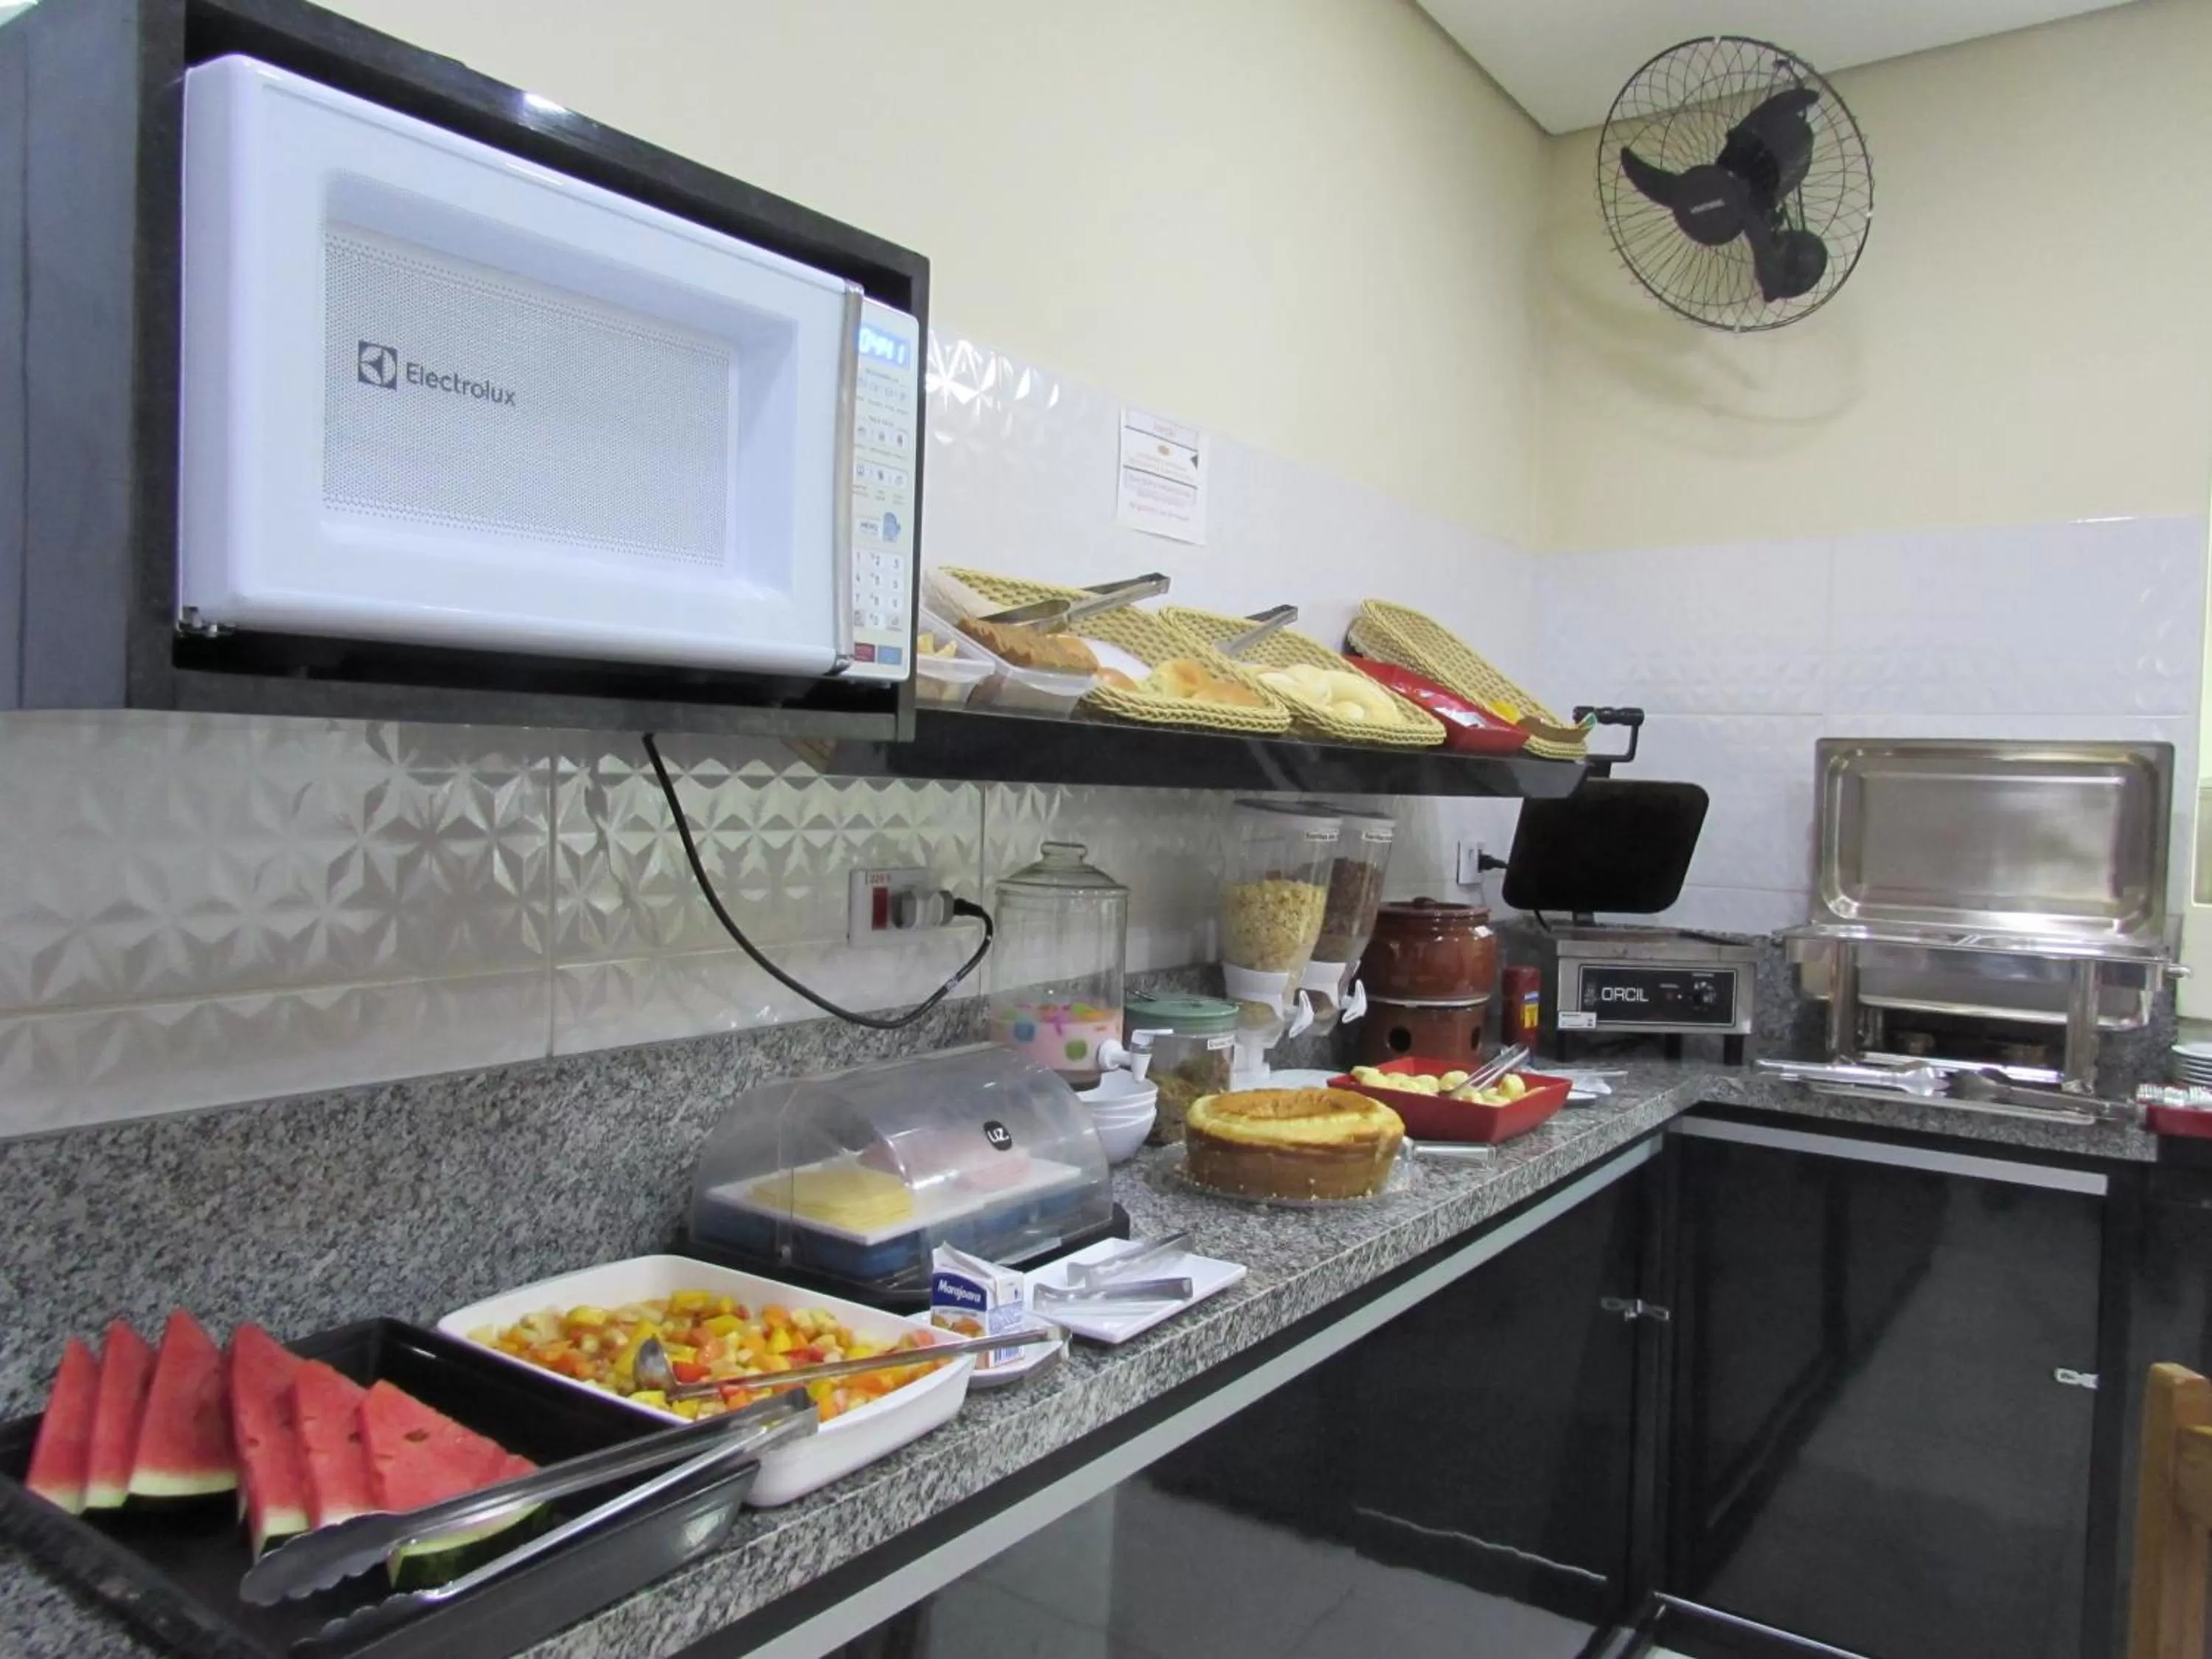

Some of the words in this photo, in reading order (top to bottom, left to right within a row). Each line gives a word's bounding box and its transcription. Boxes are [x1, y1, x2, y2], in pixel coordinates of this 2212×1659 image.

[406, 362, 516, 406] Electrolux
[1601, 987, 1649, 1002] ORCIL
[937, 1279, 982, 1304] Marajoara
